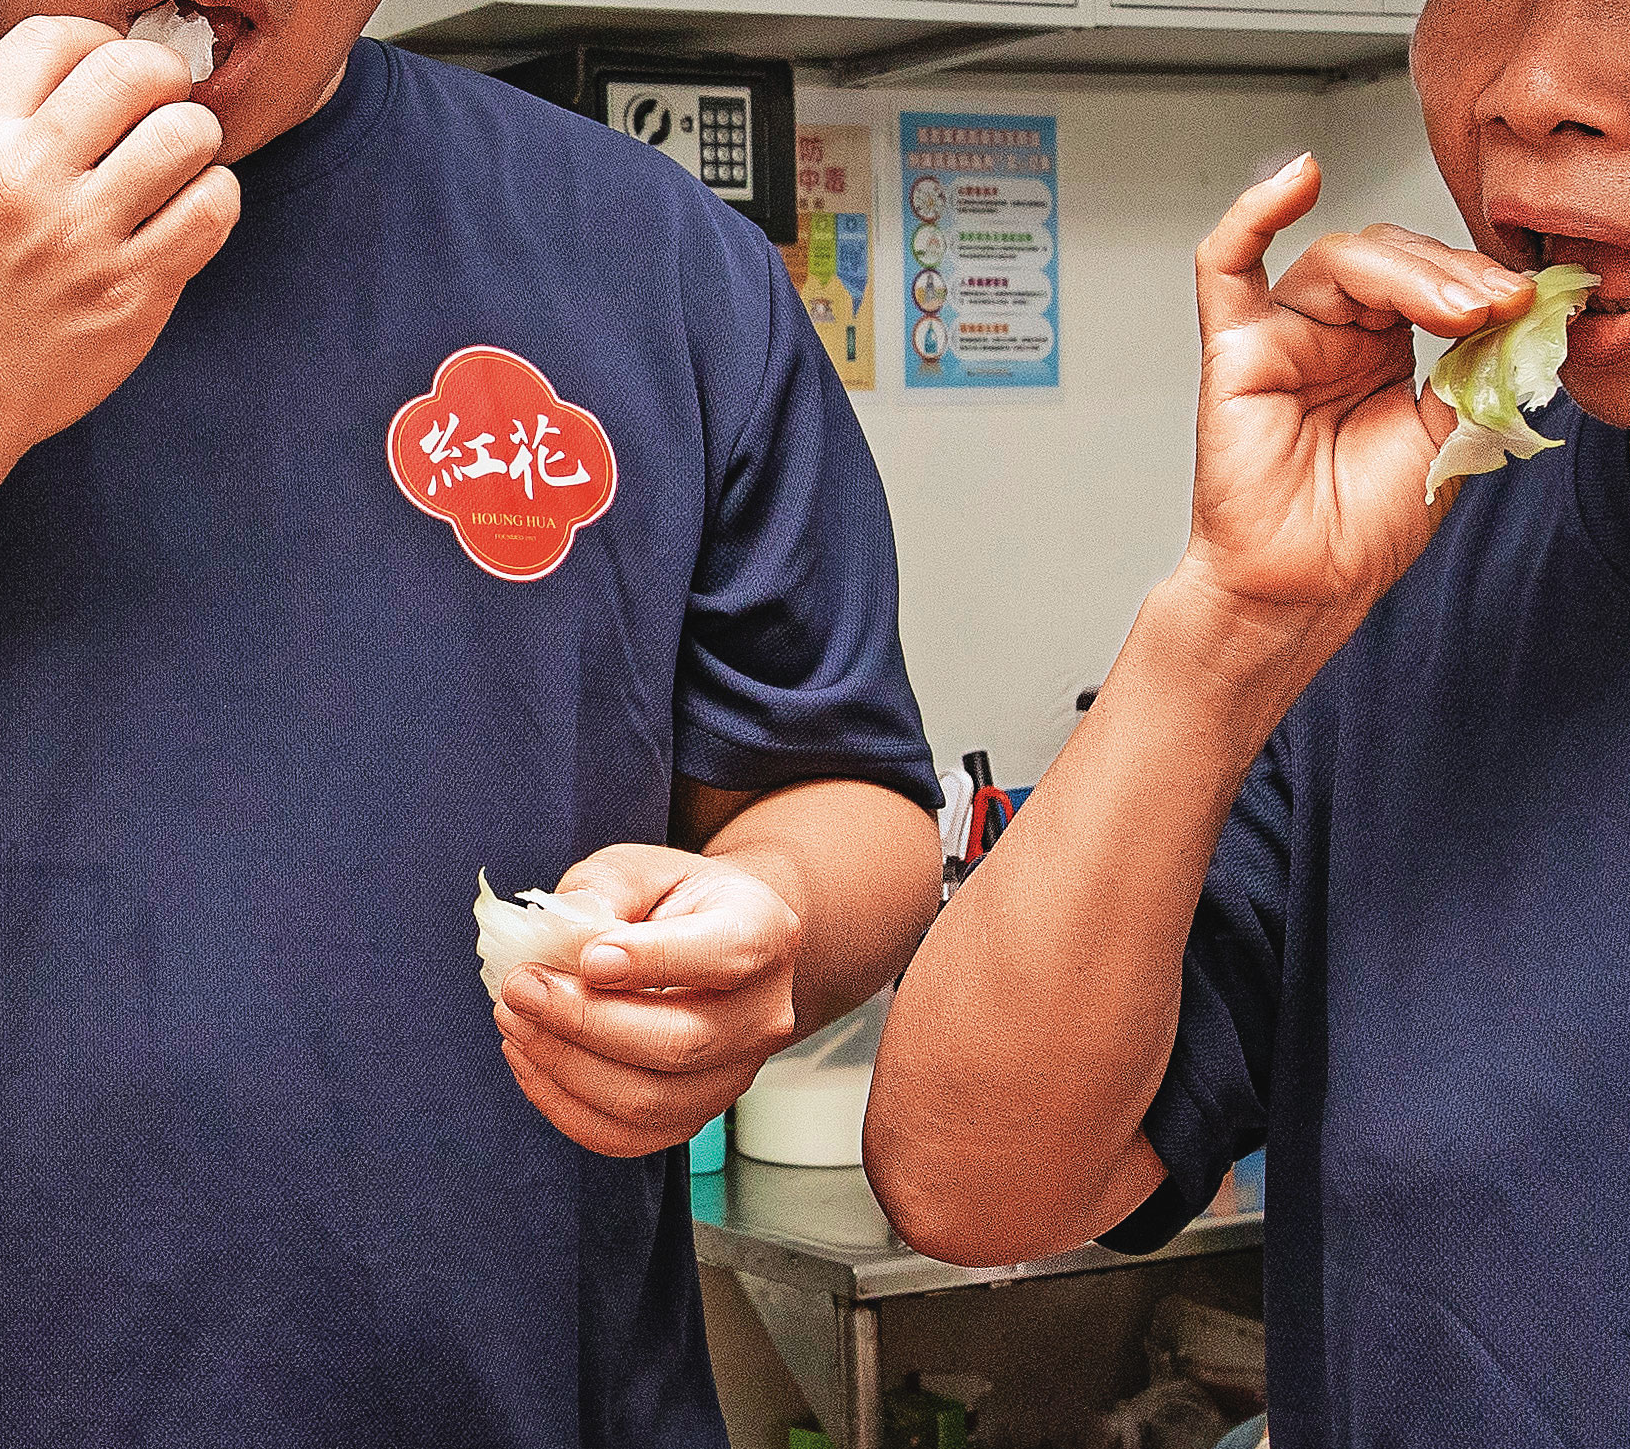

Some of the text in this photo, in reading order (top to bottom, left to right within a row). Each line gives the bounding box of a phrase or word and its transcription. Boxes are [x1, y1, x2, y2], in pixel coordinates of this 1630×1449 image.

[418, 411, 591, 501] 紅花
[471, 512, 557, 529] HOUNG HUA
